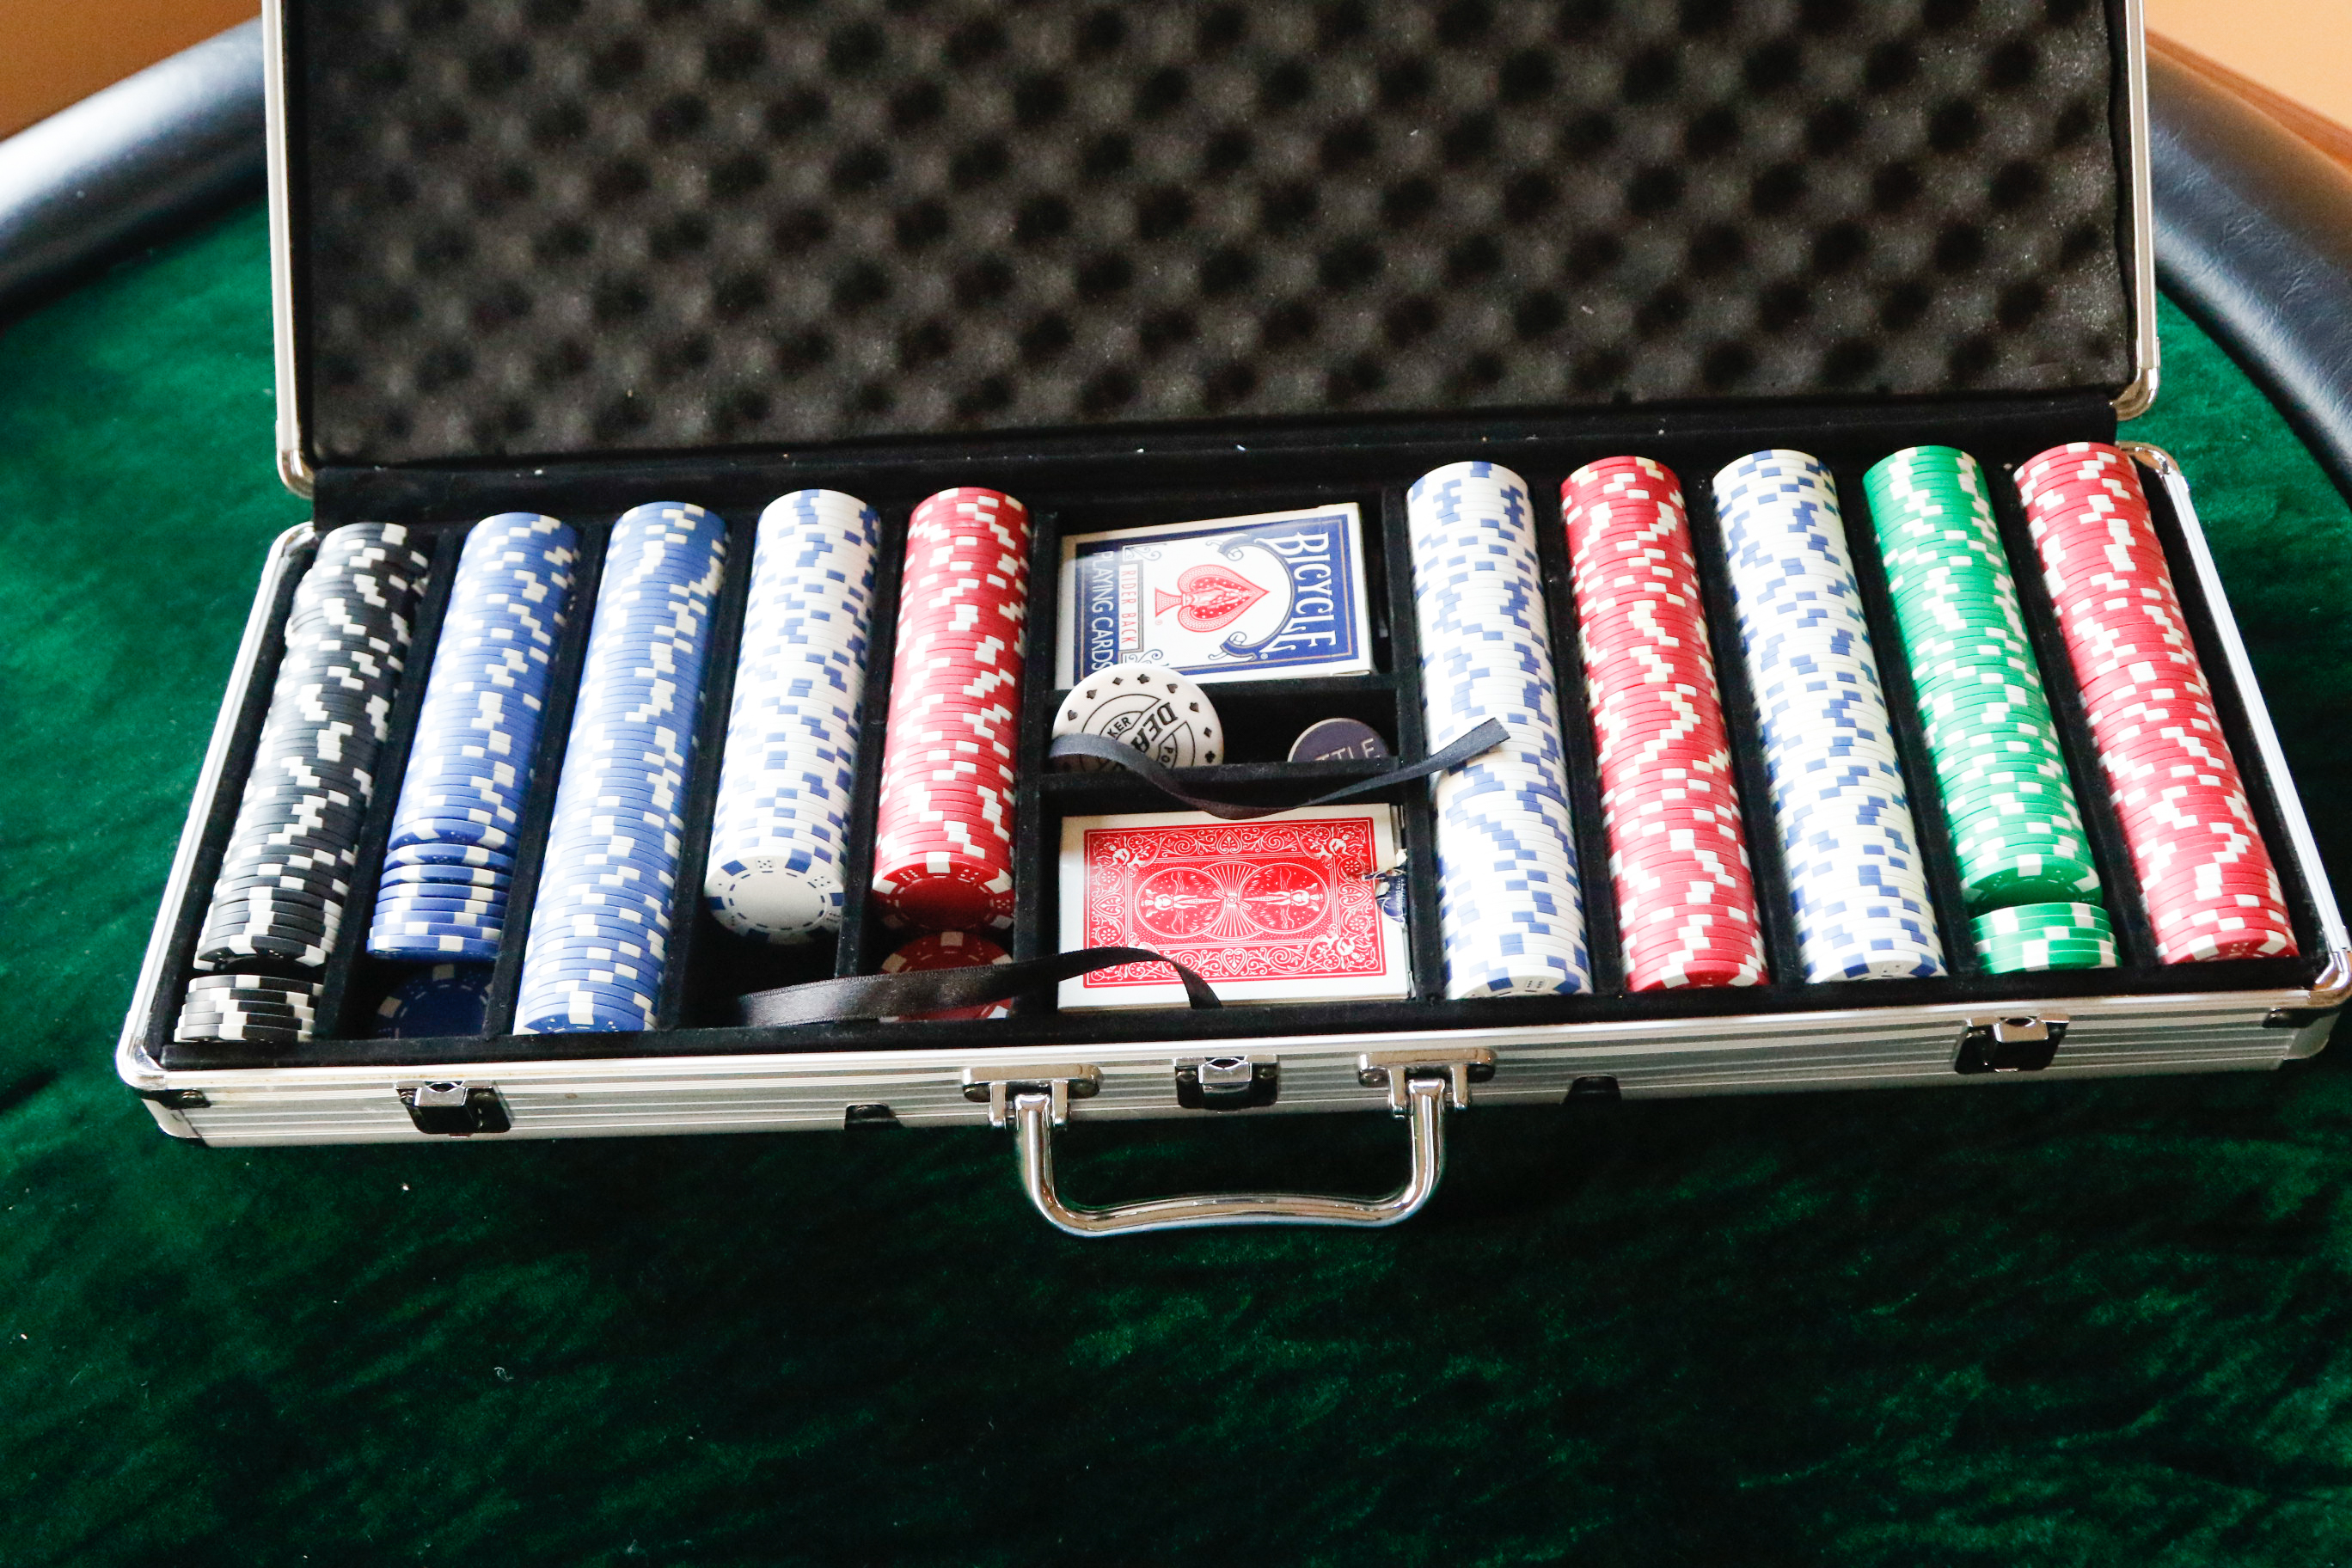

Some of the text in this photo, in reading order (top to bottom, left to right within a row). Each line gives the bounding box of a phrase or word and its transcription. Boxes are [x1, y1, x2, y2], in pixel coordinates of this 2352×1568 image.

[1091, 550, 1114, 671] PLAYING CARDS
[1121, 570, 1136, 644] RIDER BACK
[1253, 531, 1337, 653] BICYCLE
